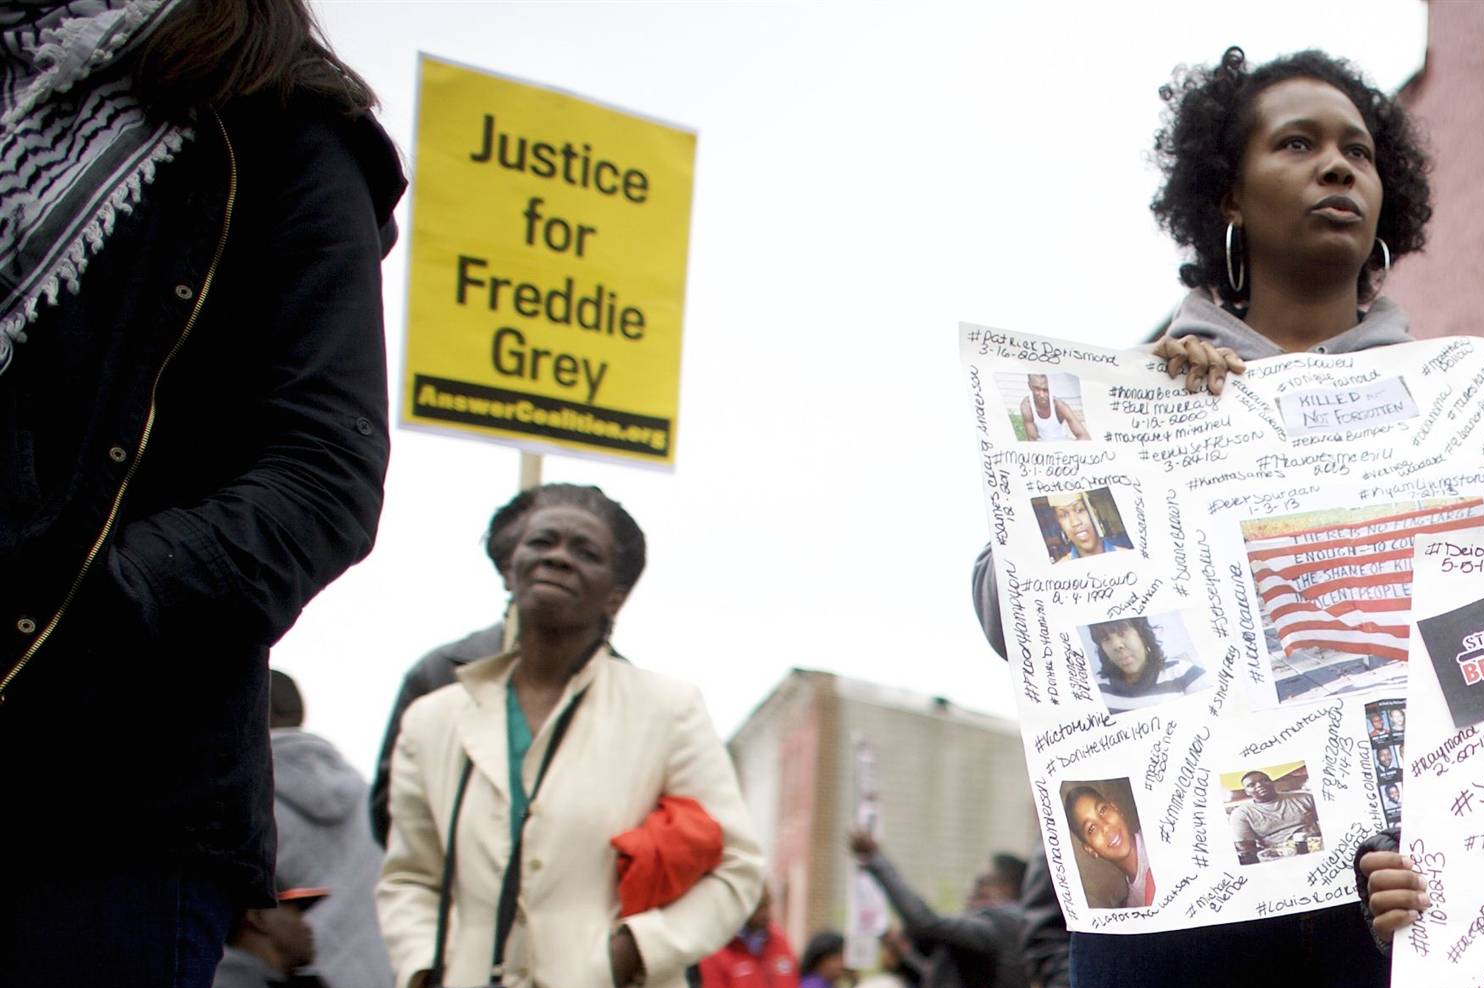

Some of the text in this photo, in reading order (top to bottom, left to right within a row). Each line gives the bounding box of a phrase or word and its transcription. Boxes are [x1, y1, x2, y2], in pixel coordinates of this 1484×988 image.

[470, 114, 650, 204] Justice
[523, 197, 596, 258] for
[455, 254, 645, 342] Freddie
[491, 327, 608, 402] Grey
[1299, 391, 1361, 407] KILLED
[1303, 400, 1404, 427] NOT FORGOTTEN
[1293, 527, 1347, 545] THERE
[1294, 546, 1357, 564] ENOUGH
[1359, 583, 1412, 600] PEOPLE
